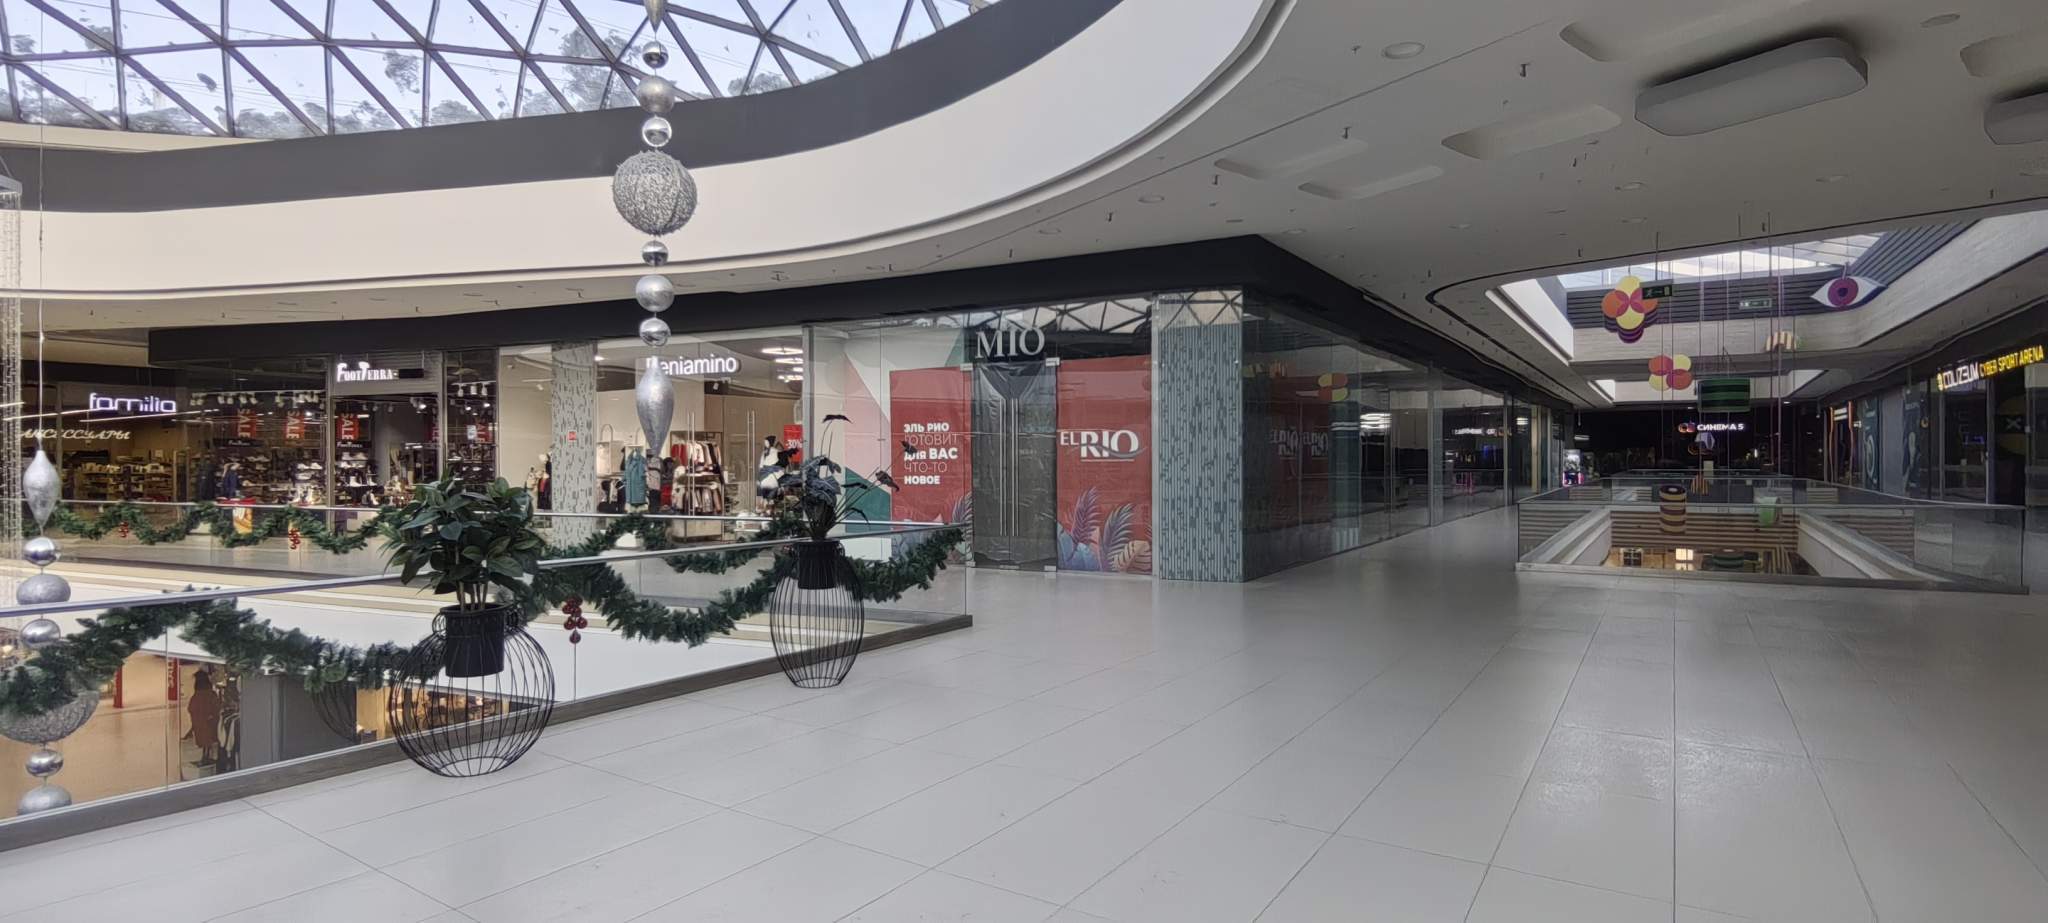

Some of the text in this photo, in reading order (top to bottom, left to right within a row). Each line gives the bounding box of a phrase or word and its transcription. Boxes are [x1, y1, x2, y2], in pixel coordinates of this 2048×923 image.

[975, 326, 1045, 359] MIO
[1998, 353, 2019, 372] SPORT
[2019, 345, 2044, 366] ARENA
[904, 422, 950, 433] ЭЛЬ РИО
[1060, 429, 1140, 459] EL RIO
[929, 447, 958, 460] ВАС
[904, 461, 948, 473] ЧТО-ТО
[904, 475, 940, 485] НОВОЕ
